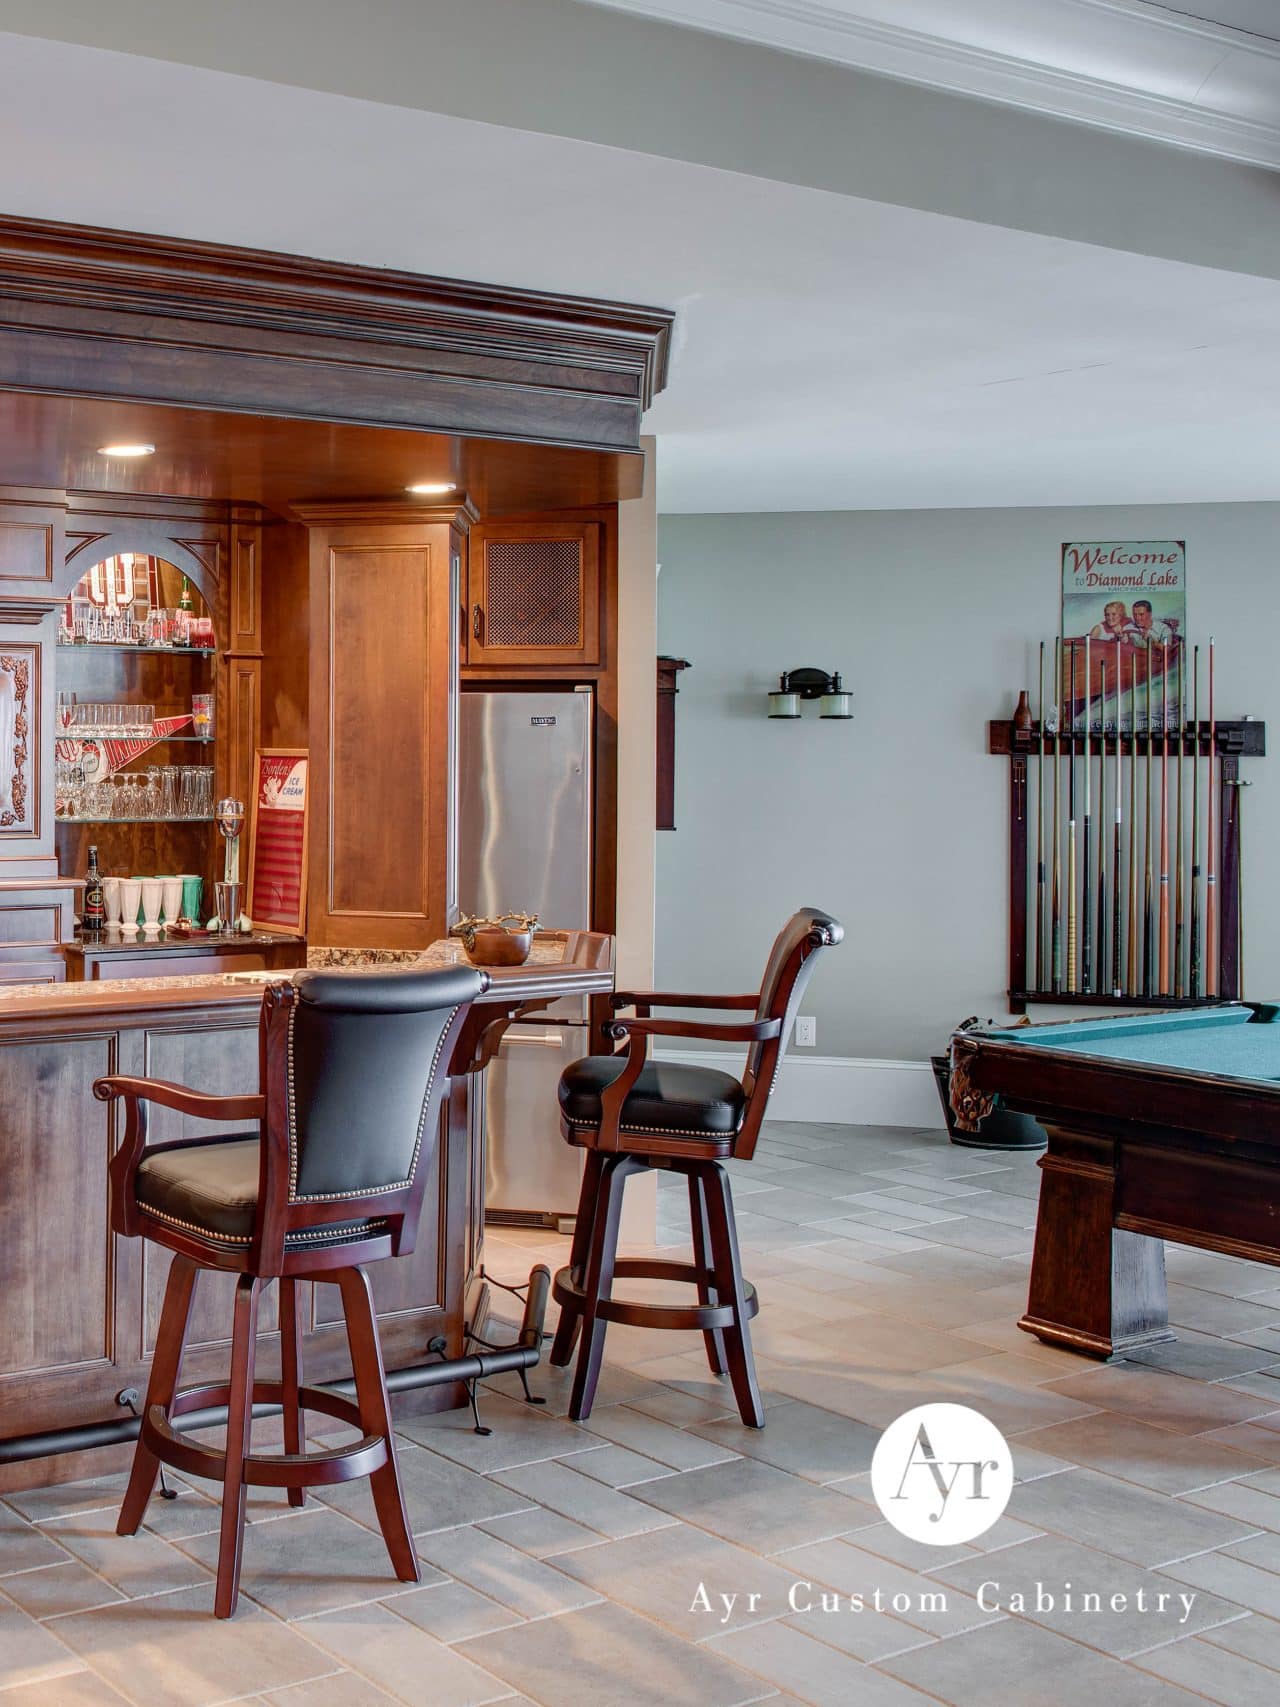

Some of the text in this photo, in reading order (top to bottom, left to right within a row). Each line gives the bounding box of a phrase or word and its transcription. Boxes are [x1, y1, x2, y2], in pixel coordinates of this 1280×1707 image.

[1069, 546, 1179, 573] Welcome
[1075, 569, 1178, 587] to Diamond Lake
[289, 777, 300, 786] ICE
[282, 786, 304, 796] CREAM
